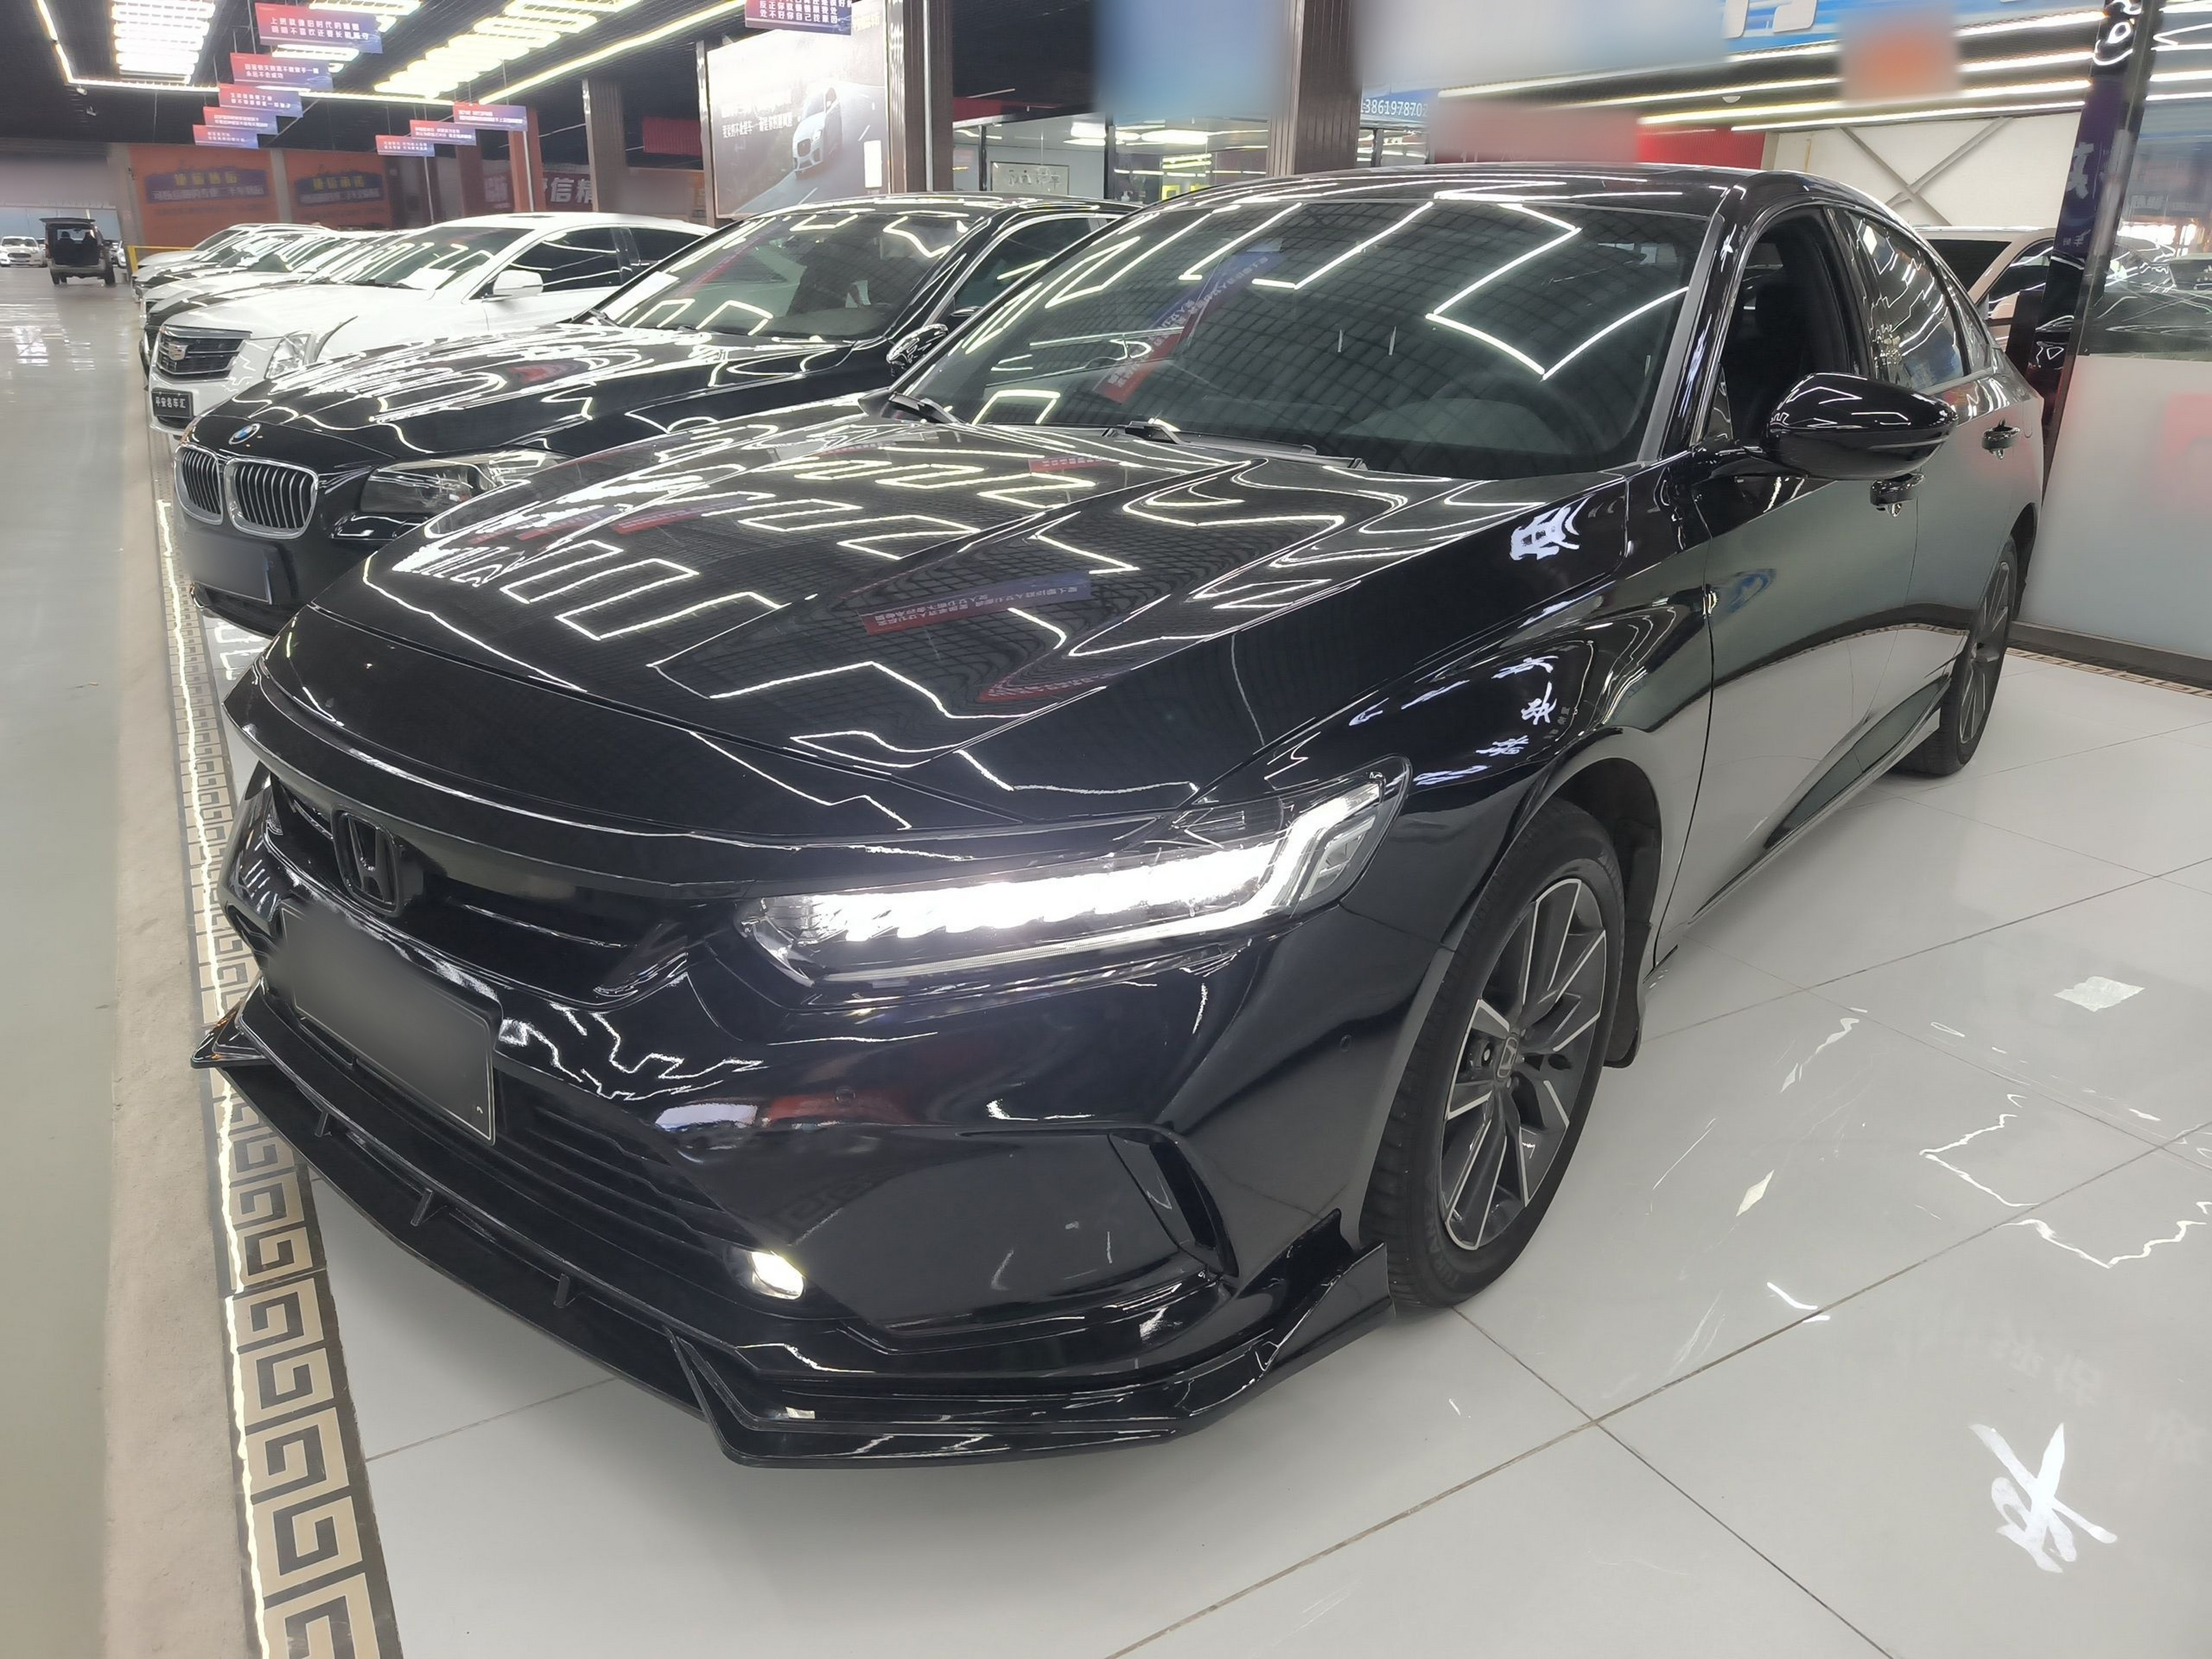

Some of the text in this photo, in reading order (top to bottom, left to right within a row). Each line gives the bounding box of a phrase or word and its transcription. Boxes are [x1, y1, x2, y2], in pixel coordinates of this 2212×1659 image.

[760, 9, 838, 24] 处不好你自己找原因
[156, 396, 186, 408] 平安名车汇
